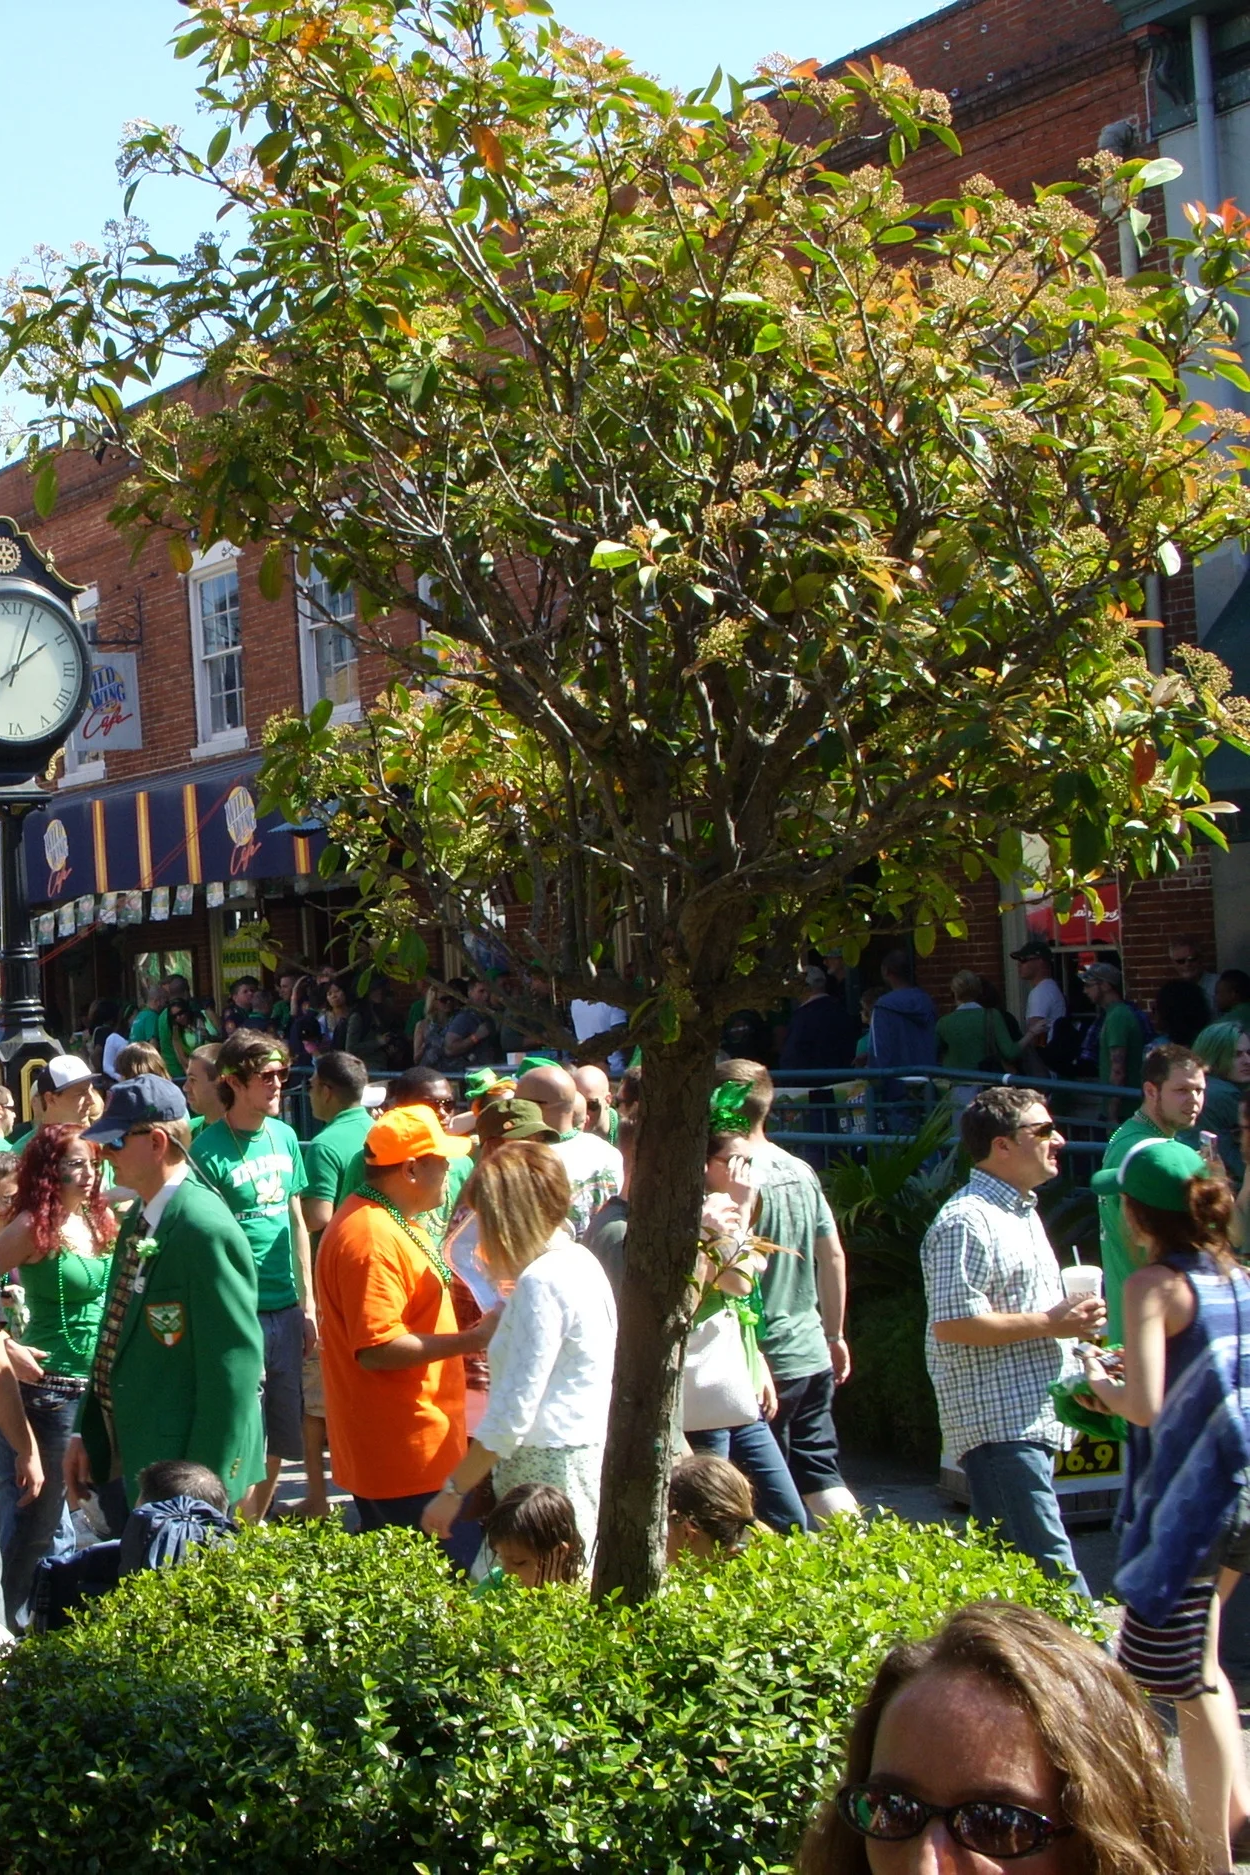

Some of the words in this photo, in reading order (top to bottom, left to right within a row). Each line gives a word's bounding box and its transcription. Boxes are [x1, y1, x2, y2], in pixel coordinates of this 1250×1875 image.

[1, 602, 23, 615] XII
[54, 632, 68, 646] II
[63, 661, 76, 678] III
[92, 667, 115, 690] ILD
[90, 682, 126, 709] WING
